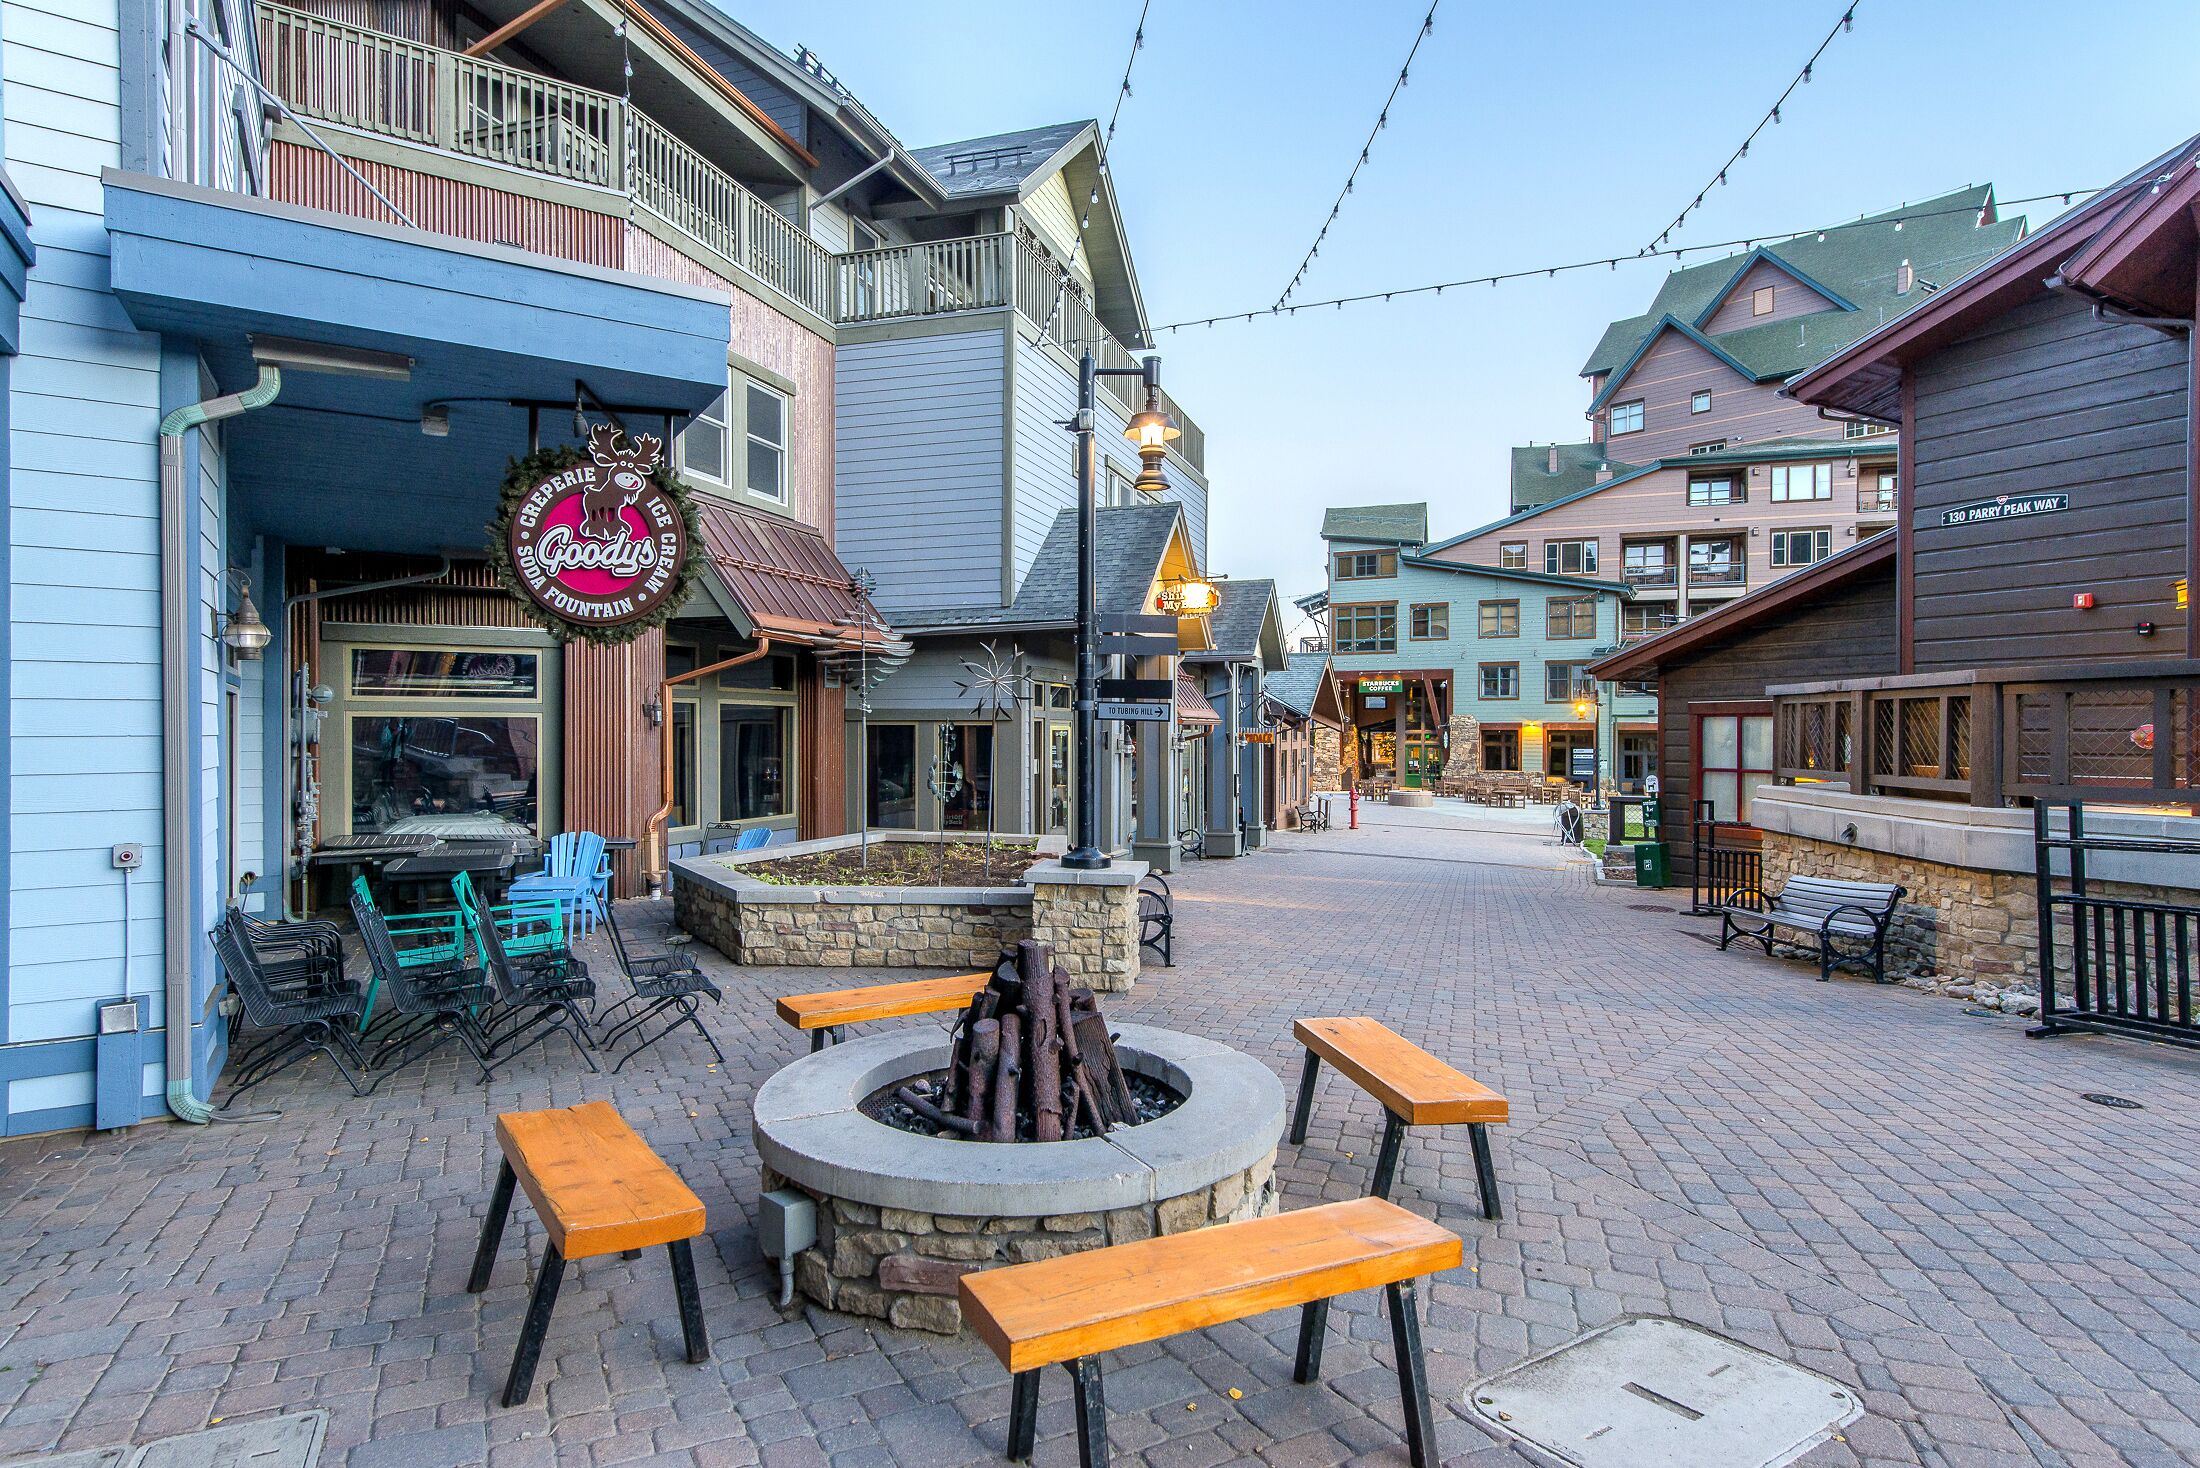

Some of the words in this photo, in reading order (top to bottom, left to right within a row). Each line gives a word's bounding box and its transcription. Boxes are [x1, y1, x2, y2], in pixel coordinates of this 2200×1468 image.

[521, 467, 596, 528] CREPERIE
[646, 496, 673, 528] ICE
[1949, 511, 1966, 523] 130
[1969, 506, 2002, 520] PARRY
[2004, 501, 2032, 515] PEAK
[2033, 497, 2060, 511] WAY
[535, 524, 657, 577] Goodys
[650, 532, 677, 594] CREAM
[517, 545, 547, 591] SODA
[543, 586, 634, 618] FOUNTAIN
[1109, 707, 1116, 715] TO
[1117, 707, 1139, 715] TUBING
[1141, 708, 1153, 716] HILL
